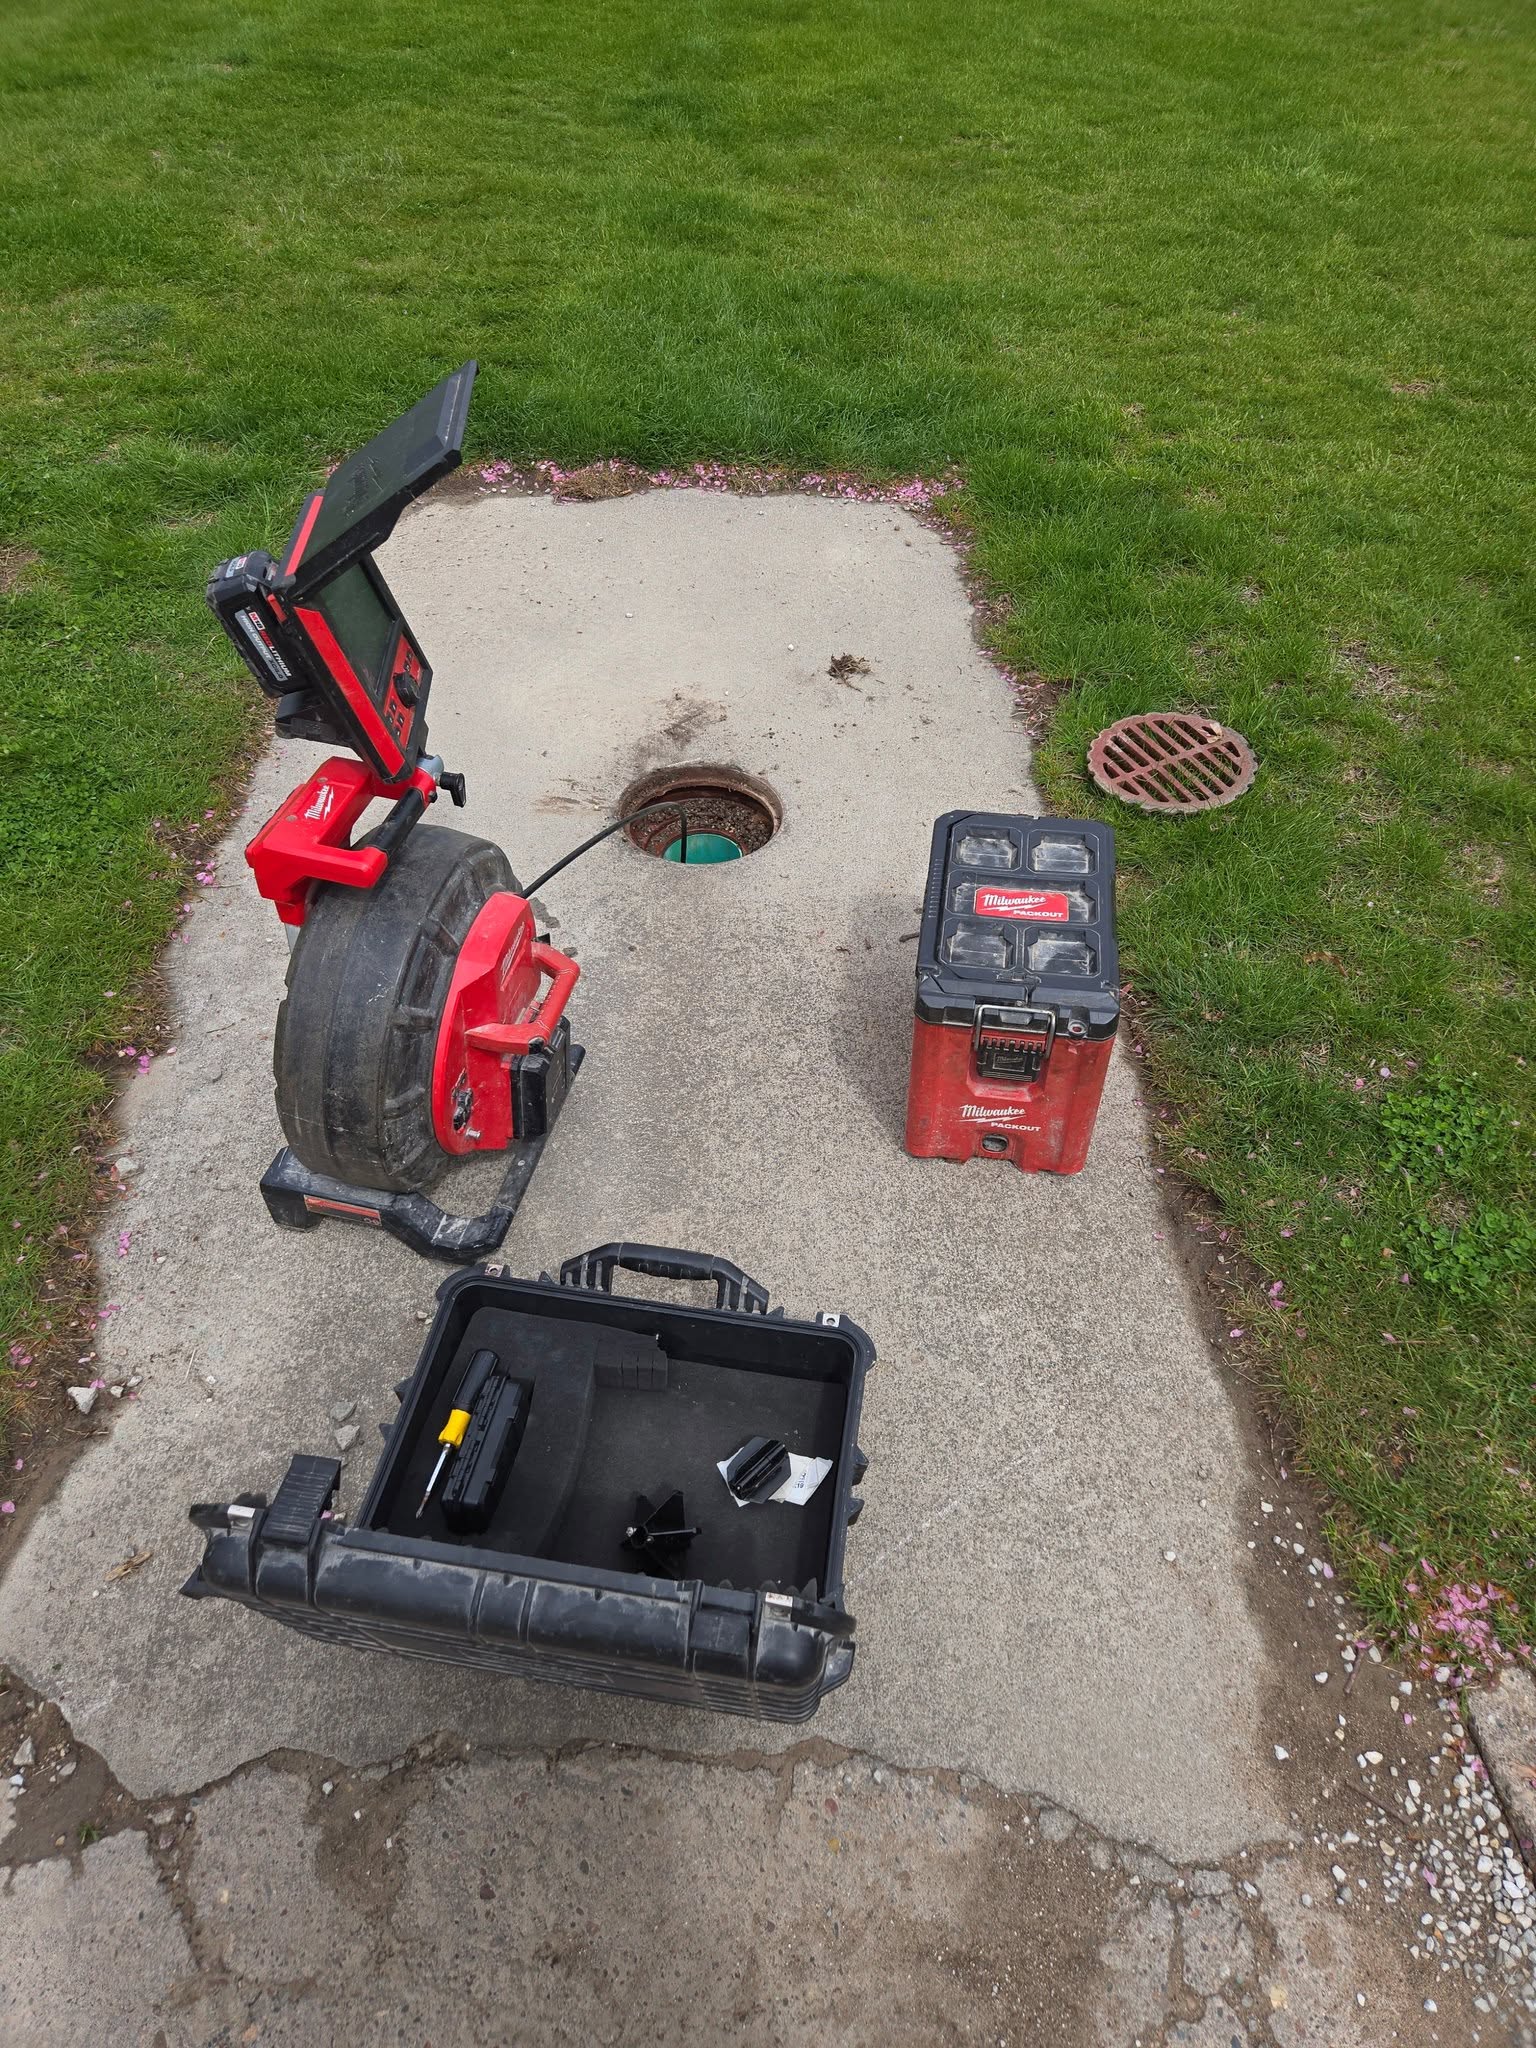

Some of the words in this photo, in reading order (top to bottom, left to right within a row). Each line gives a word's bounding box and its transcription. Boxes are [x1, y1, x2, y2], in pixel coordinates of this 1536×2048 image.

[252, 633, 271, 659] OUTPUT
[981, 893, 1046, 907] Milwaukee
[1013, 909, 1063, 918] PACKOUT
[960, 1104, 1025, 1118] Milwaukee
[991, 1122, 1041, 1132] PACKOUT
